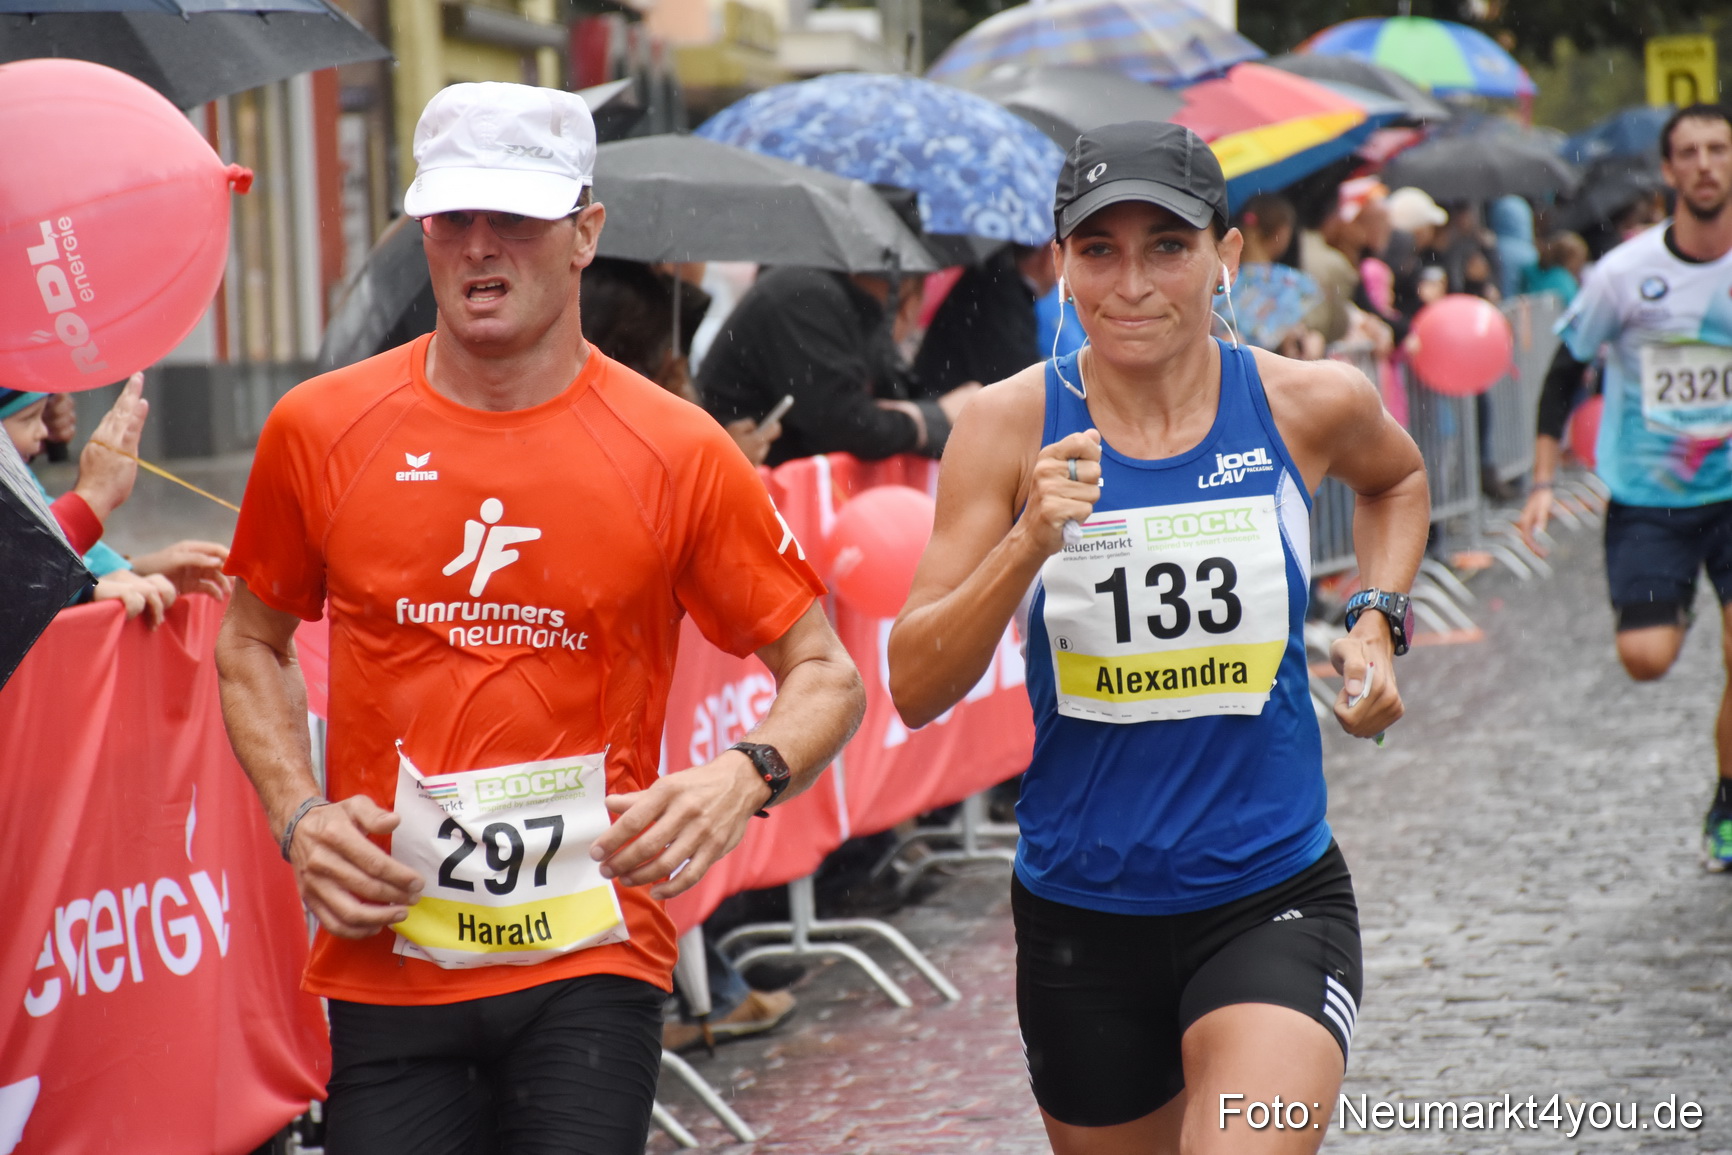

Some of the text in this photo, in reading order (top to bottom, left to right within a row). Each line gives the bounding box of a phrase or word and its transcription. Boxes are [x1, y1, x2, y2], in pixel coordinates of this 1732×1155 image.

[27, 219, 109, 374] RÖDL
[395, 469, 438, 481] erima
[1197, 467, 1247, 489] LCAV
[1246, 465, 1274, 473] PACKAGING
[1143, 507, 1258, 542] BOCK
[1147, 534, 1261, 552] inspired by smart concepts
[396, 598, 566, 628] funrunners
[1095, 556, 1242, 643] 133
[449, 624, 589, 651] neumarkt
[1059, 637, 1068, 650] B
[1096, 657, 1248, 695] Alexandra
[475, 766, 585, 804] BOCK
[513, 799, 524, 809] by
[549, 791, 586, 803] concepts
[437, 814, 564, 896] 297
[458, 911, 552, 946] Harald
